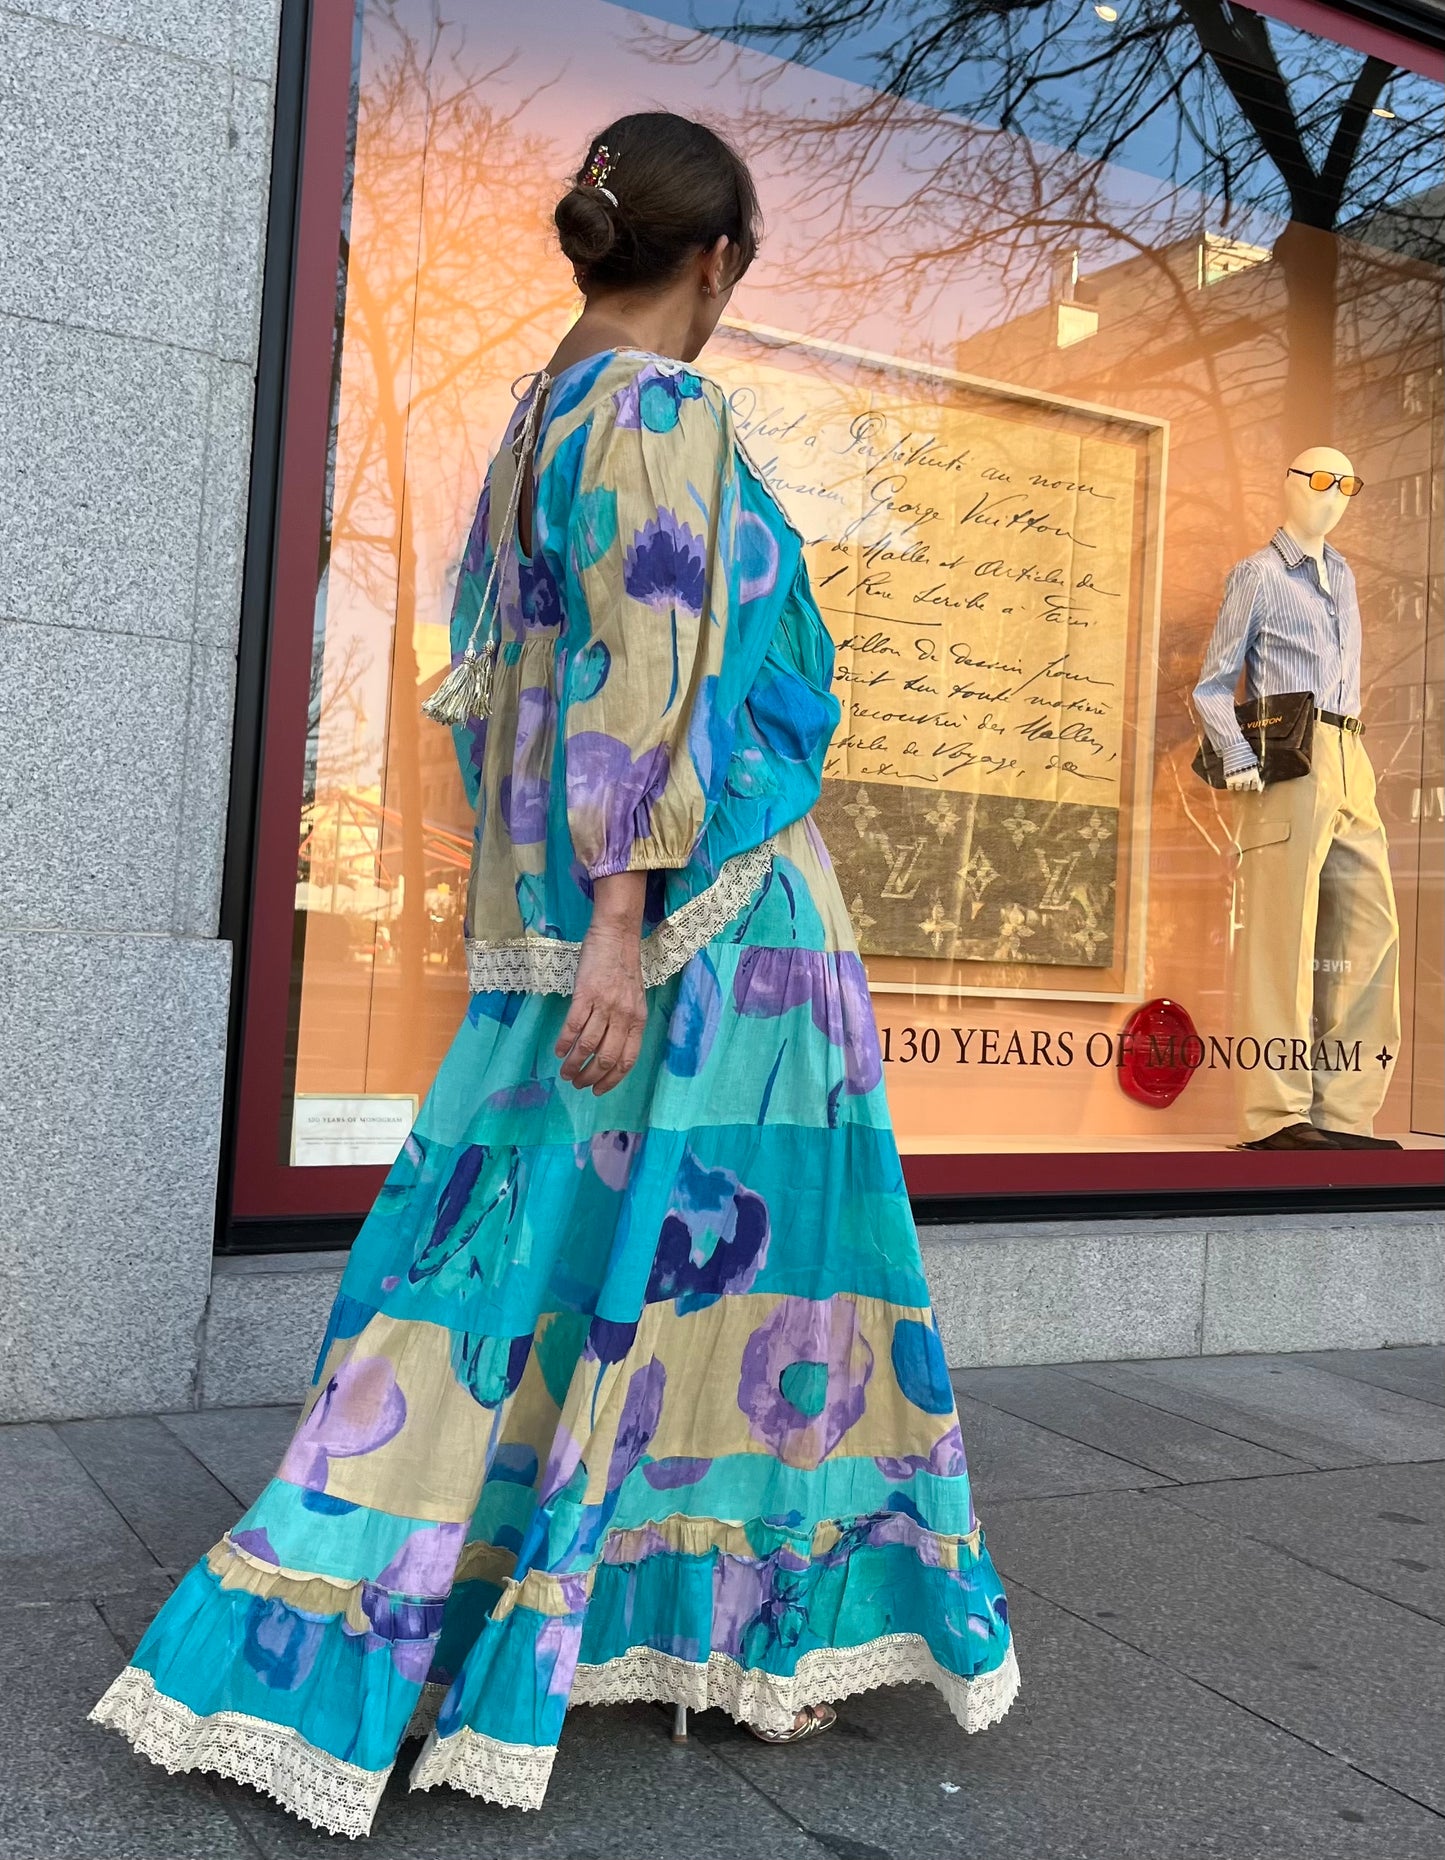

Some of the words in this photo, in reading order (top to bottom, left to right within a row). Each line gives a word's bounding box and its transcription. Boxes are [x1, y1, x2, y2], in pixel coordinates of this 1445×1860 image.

[960, 492, 1096, 548] Vuitton
[835, 632, 901, 656] tillon
[881, 1027, 941, 1064] 130
[951, 1028, 1074, 1067] YEARS
[1086, 1032, 1135, 1068] OF
[1146, 1033, 1362, 1072] MONOGRAM
